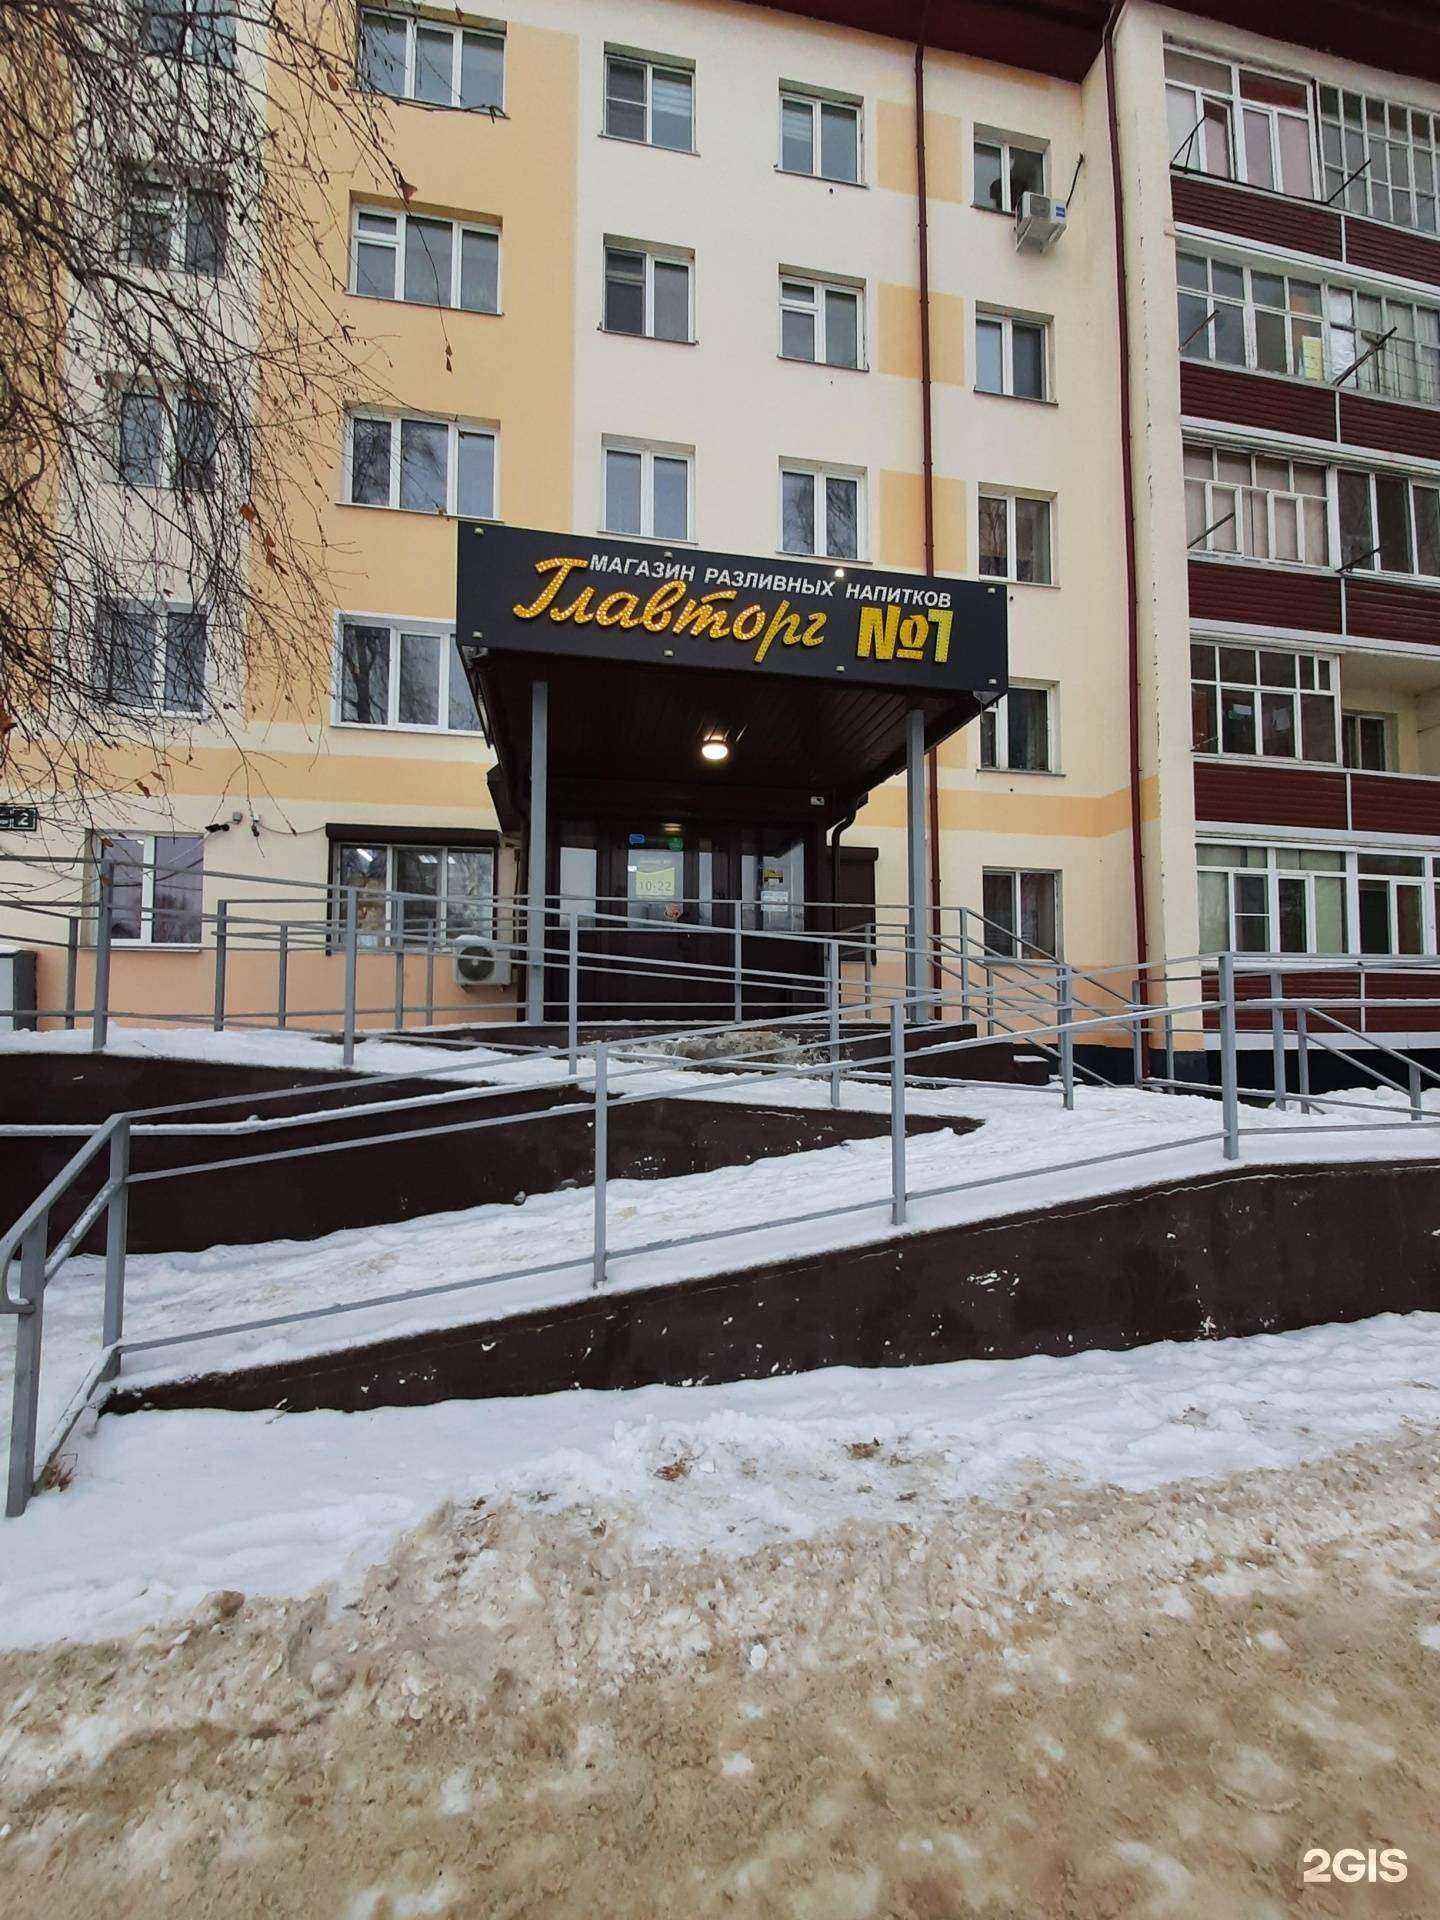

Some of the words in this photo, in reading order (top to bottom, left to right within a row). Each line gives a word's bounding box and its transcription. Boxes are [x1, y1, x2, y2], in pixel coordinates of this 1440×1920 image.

[512, 556, 827, 664] Главторг
[856, 604, 954, 663] №1
[589, 553, 695, 582] МАГАЗИН
[704, 567, 834, 597] РАЗЛИВНЫХ
[846, 582, 952, 608] НАПИТКОВ
